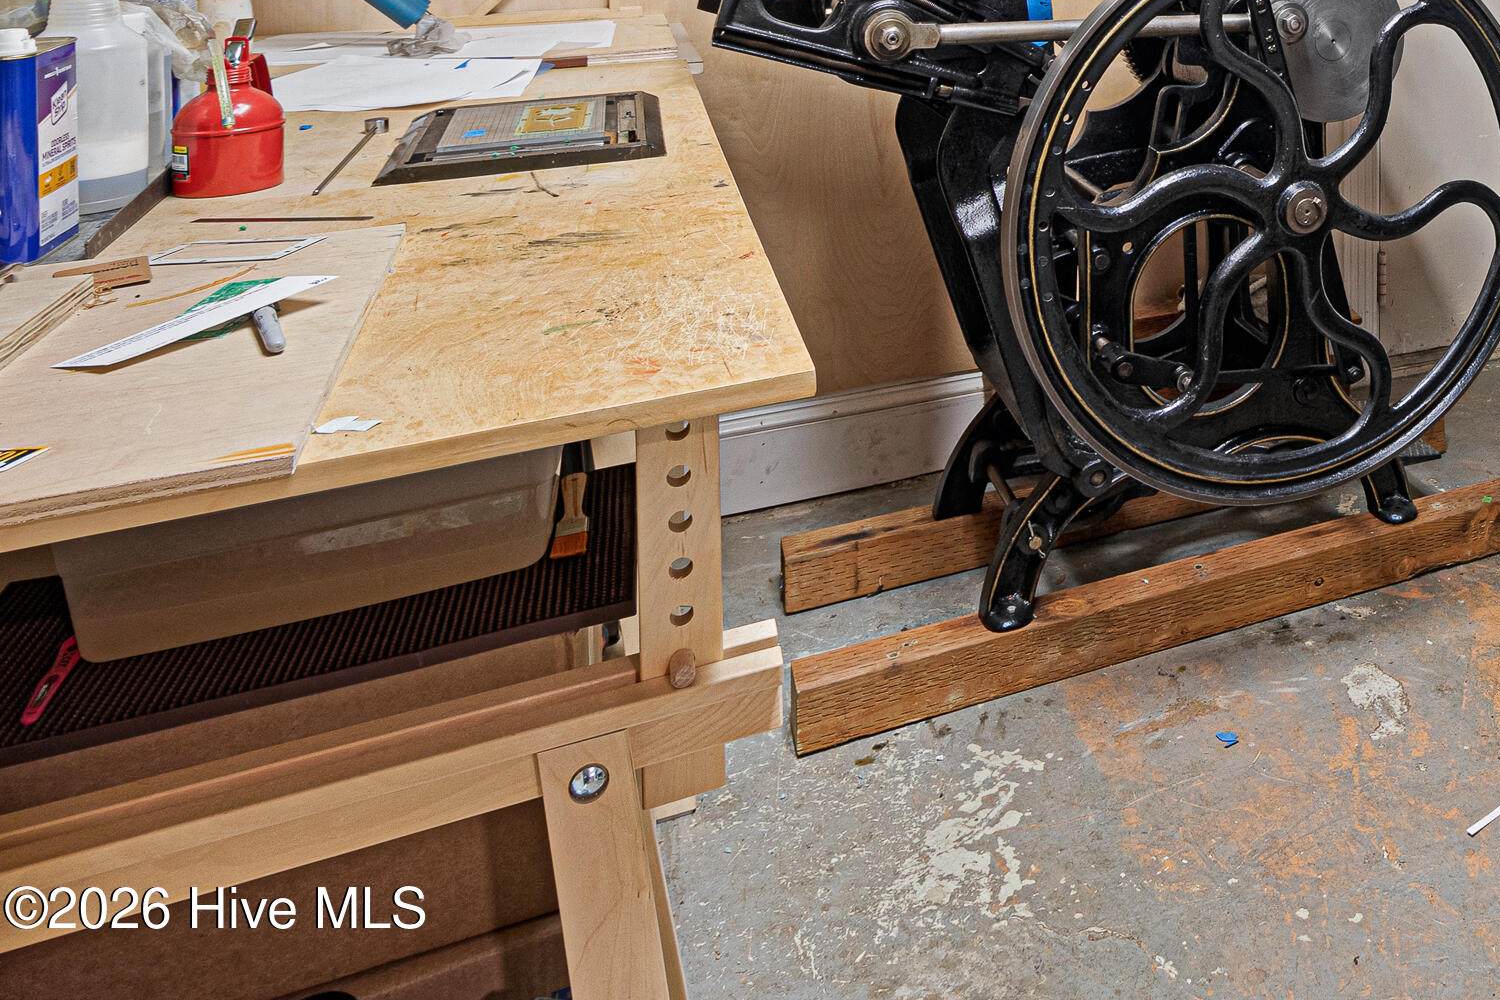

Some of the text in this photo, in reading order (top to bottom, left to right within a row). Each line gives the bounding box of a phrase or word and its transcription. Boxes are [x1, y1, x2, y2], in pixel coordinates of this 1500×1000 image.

[42, 144, 62, 160] MINERAL
[62, 136, 76, 151] SPIRITS
[51, 132, 70, 148] ODORLESS
